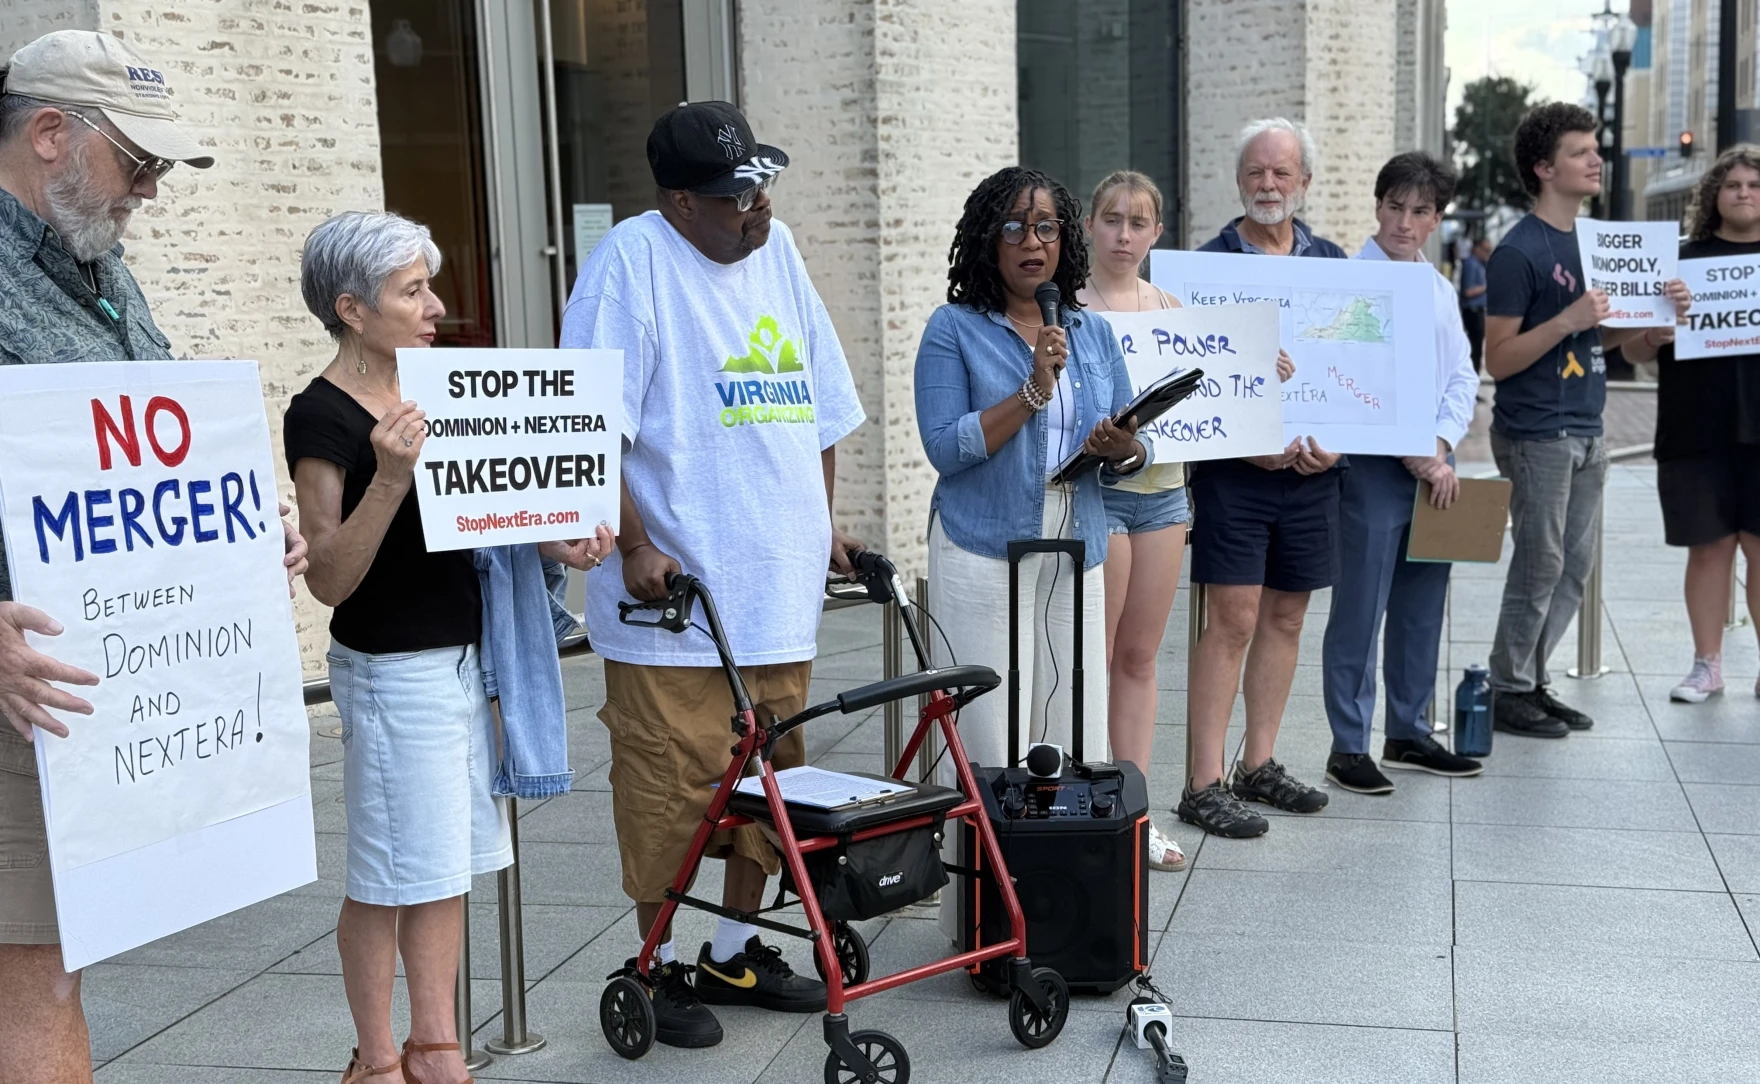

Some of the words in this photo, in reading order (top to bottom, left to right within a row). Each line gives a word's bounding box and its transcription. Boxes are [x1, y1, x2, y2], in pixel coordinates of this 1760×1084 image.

[1597, 232, 1642, 249] BIGGER
[1706, 265, 1755, 282] STOP
[1191, 291, 1228, 305] KEEP
[1233, 291, 1290, 309] VIRIA
[1690, 290, 1748, 303] OMINION
[1152, 328, 1237, 358] POWER
[448, 369, 519, 399] STOP
[523, 369, 575, 397] THE
[714, 380, 813, 407] VIRGINIA
[1228, 374, 1266, 399] THE
[1281, 382, 1328, 403] EXTERA
[1327, 366, 1381, 410] MERGER
[524, 414, 607, 434] NEXTERA
[720, 405, 816, 428] ORGANIZING
[1146, 416, 1228, 442] AKEOVER
[91, 395, 192, 471] NO
[424, 453, 606, 496] TAKEOVER!
[32, 469, 266, 564] MERGER!
[456, 510, 580, 535] StopNextEra.com
[83, 584, 194, 621] BETWEEN
[103, 618, 252, 679] DOMINION
[130, 691, 181, 723] AND
[114, 672, 264, 785] NEXTERA!
[879, 874, 902, 887] drive
